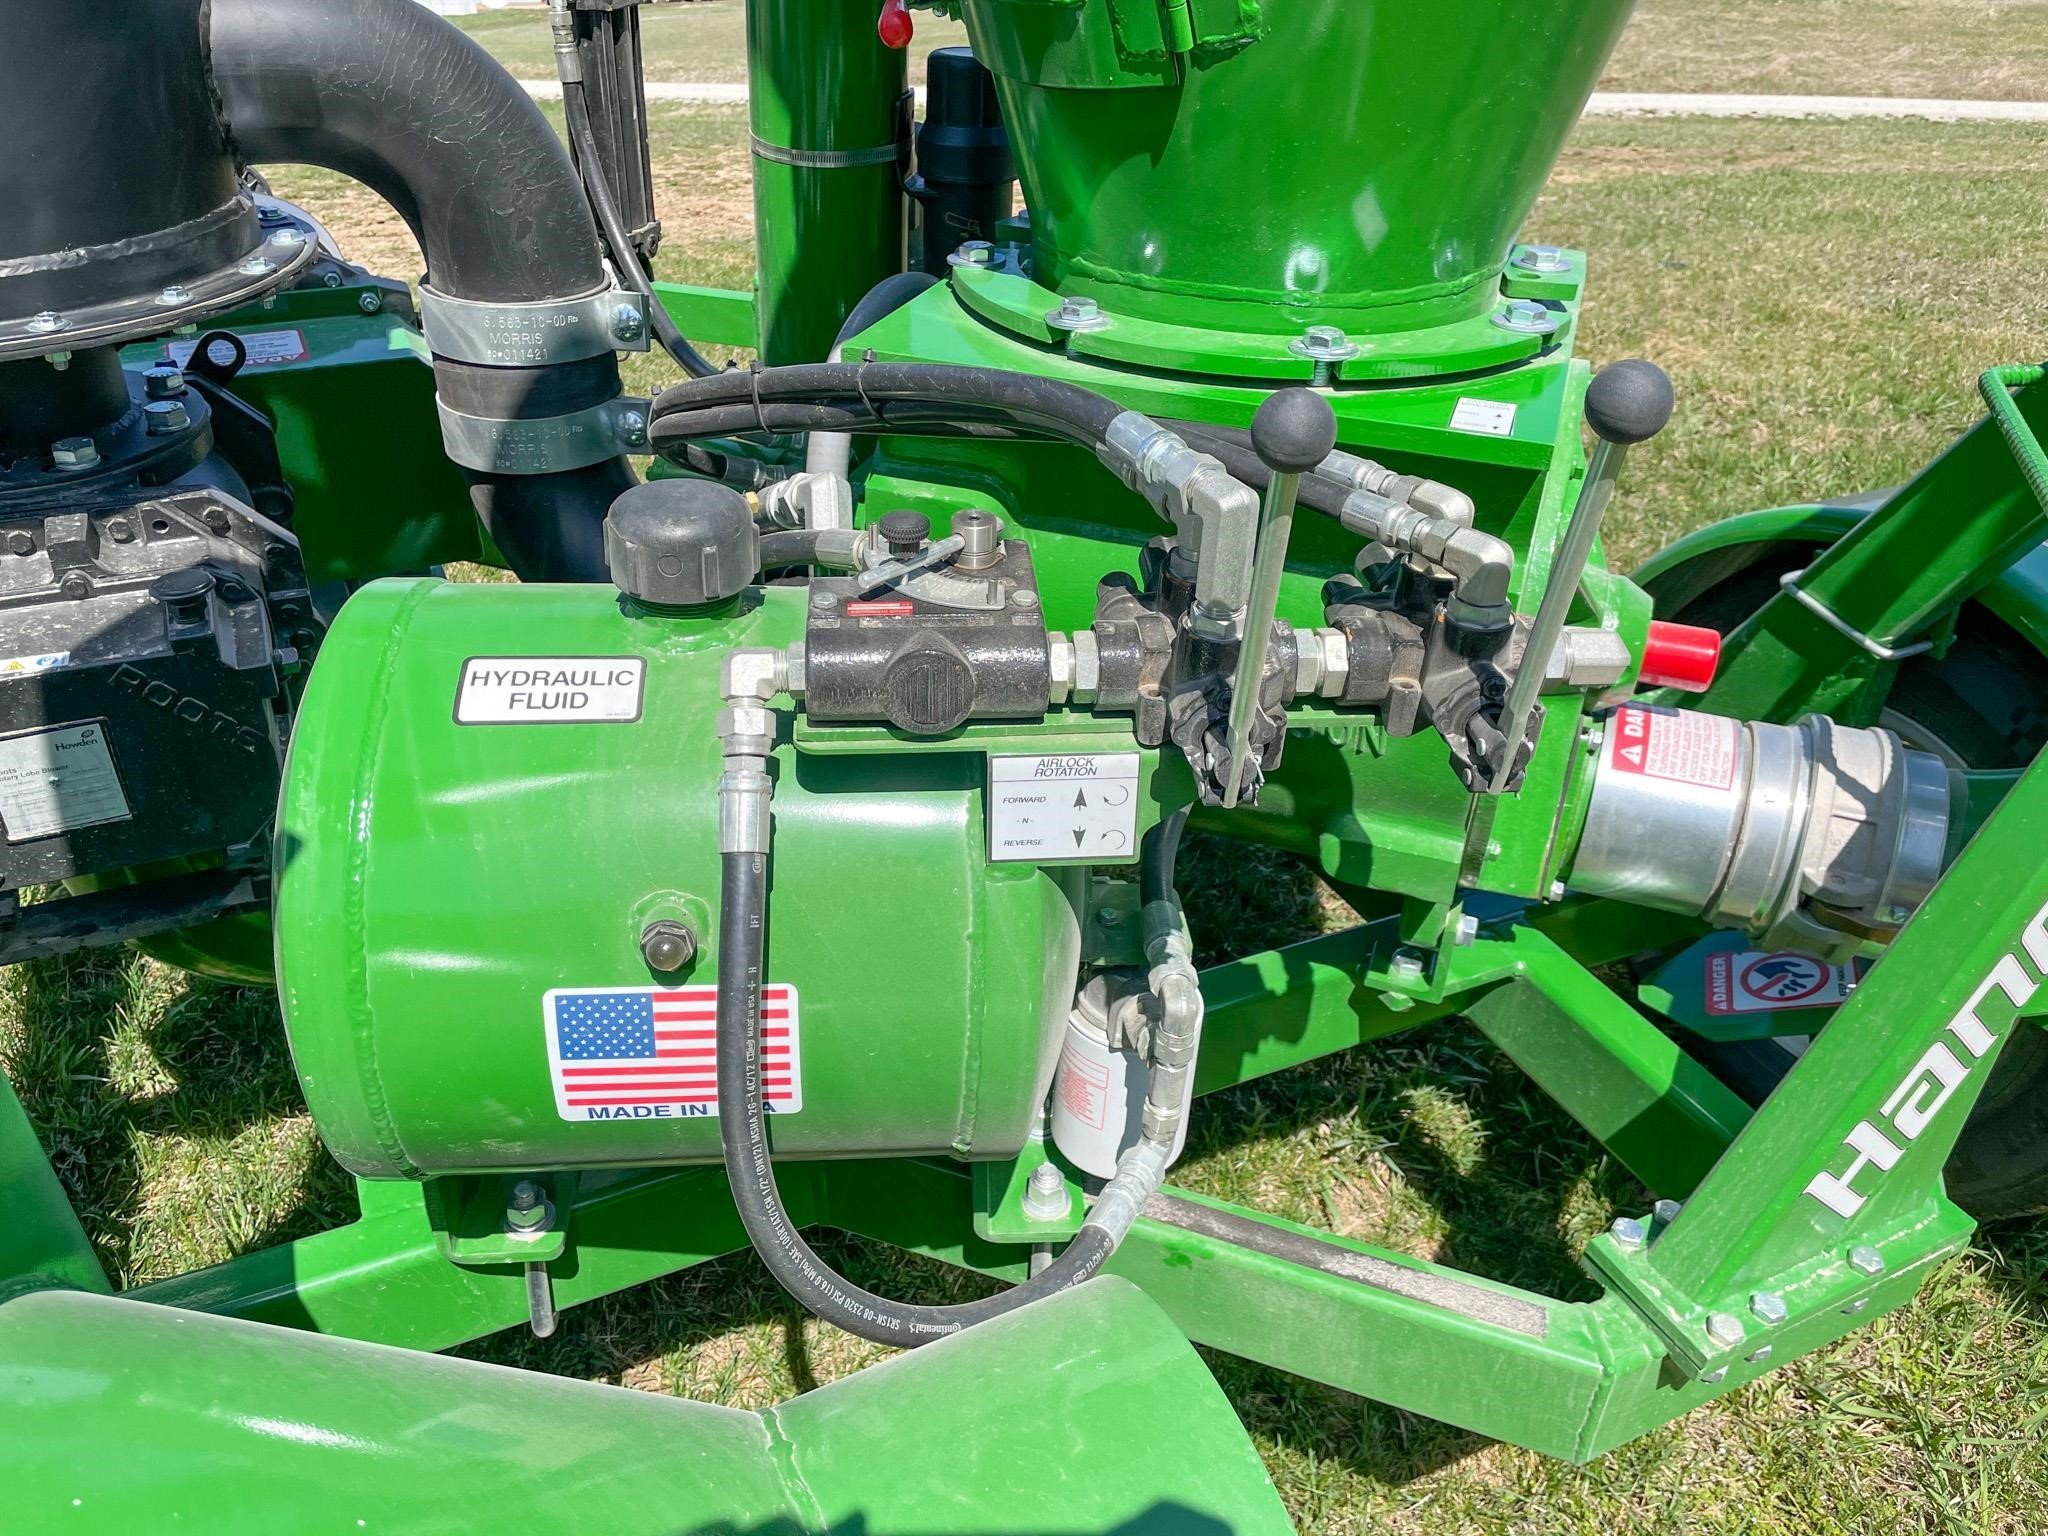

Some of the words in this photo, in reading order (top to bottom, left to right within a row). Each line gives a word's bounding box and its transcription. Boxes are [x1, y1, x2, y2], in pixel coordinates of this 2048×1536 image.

[489, 332, 543, 345] MORRIS
[470, 670, 635, 686] HYDRAULIC
[508, 691, 589, 710] FLUID
[55, 737, 98, 752] Howden
[1037, 757, 1095, 768] AIRLOCK
[1034, 767, 1098, 778] ROTATION
[1002, 796, 1047, 804] FORWARD
[1003, 839, 1044, 847] REVERSE
[1712, 957, 1727, 1001] DANGER
[588, 1105, 672, 1119] MADE
[681, 1103, 708, 1116] IN
[749, 1114, 760, 1142] MSHA
[788, 1247, 802, 1264] SAE
[844, 1297, 864, 1316] 2320
